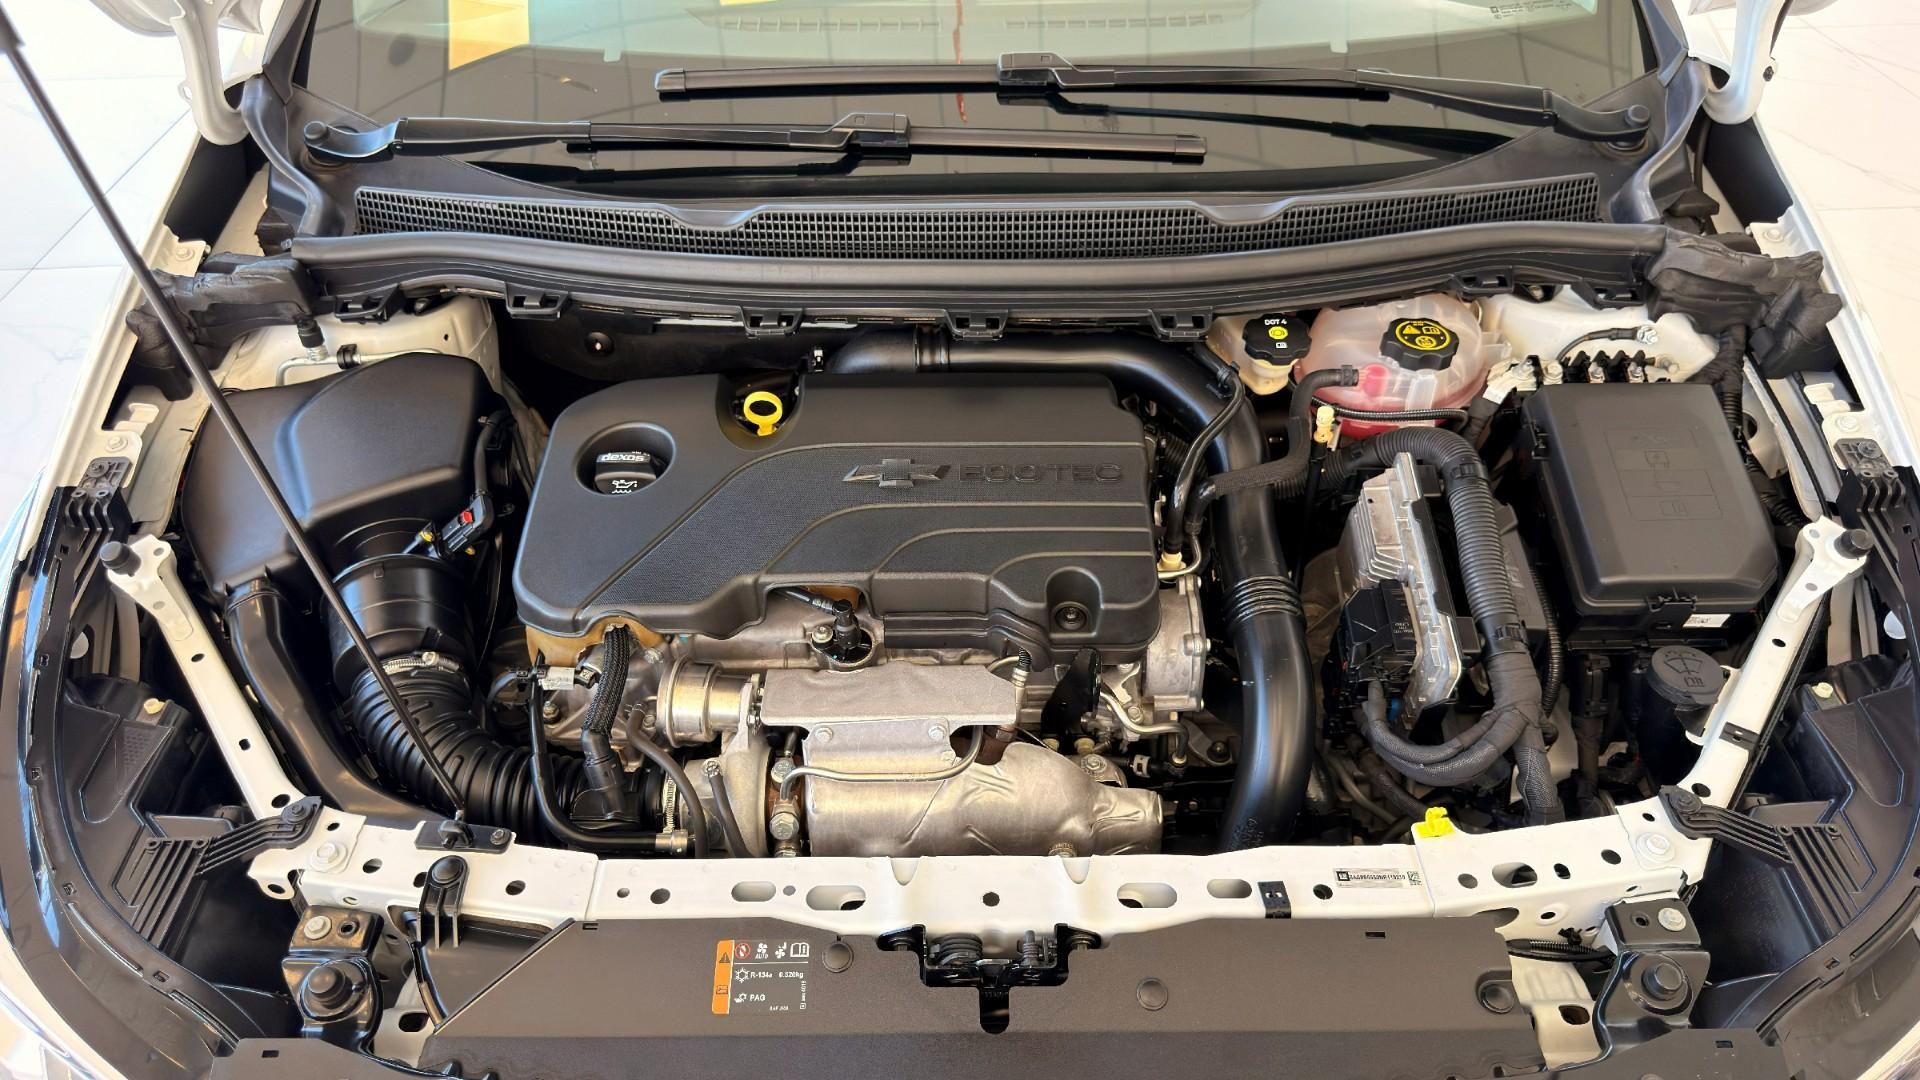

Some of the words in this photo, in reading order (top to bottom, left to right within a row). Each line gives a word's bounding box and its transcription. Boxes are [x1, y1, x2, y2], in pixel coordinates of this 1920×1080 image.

[601, 453, 645, 462] dexos
[958, 463, 1122, 483] ECOTEC
[749, 993, 766, 1002] PAG
